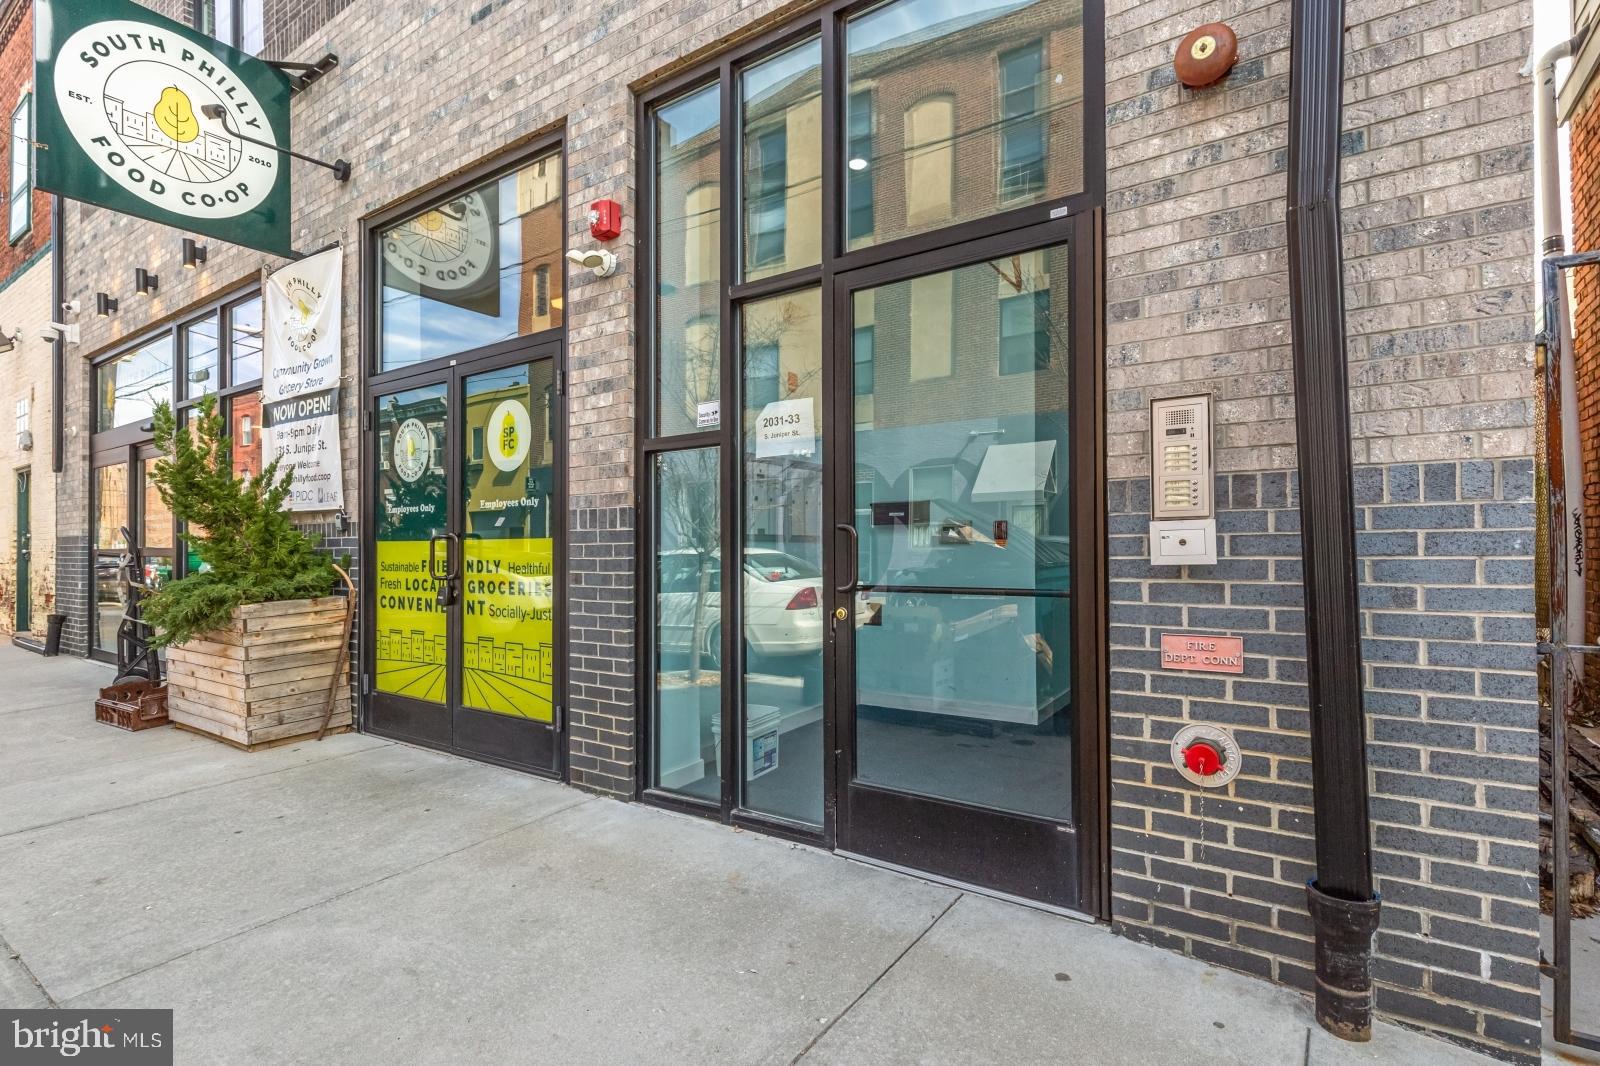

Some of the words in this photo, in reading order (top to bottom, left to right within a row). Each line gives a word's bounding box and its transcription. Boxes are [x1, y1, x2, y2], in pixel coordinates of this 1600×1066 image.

[80, 34, 166, 68] SOUTH
[181, 49, 261, 129] PHILLY
[68, 90, 93, 105] EST.
[91, 135, 166, 195] FOOD
[248, 155, 272, 168] 2010
[313, 354, 333, 370] Grown
[304, 375, 324, 390] Store
[273, 402, 296, 423] NOW
[298, 395, 331, 417] OPEN!
[763, 413, 800, 428] 2031-33
[503, 427, 514, 438] SP
[770, 431, 790, 440] Juniper
[318, 440, 327, 450] St.
[503, 438, 515, 450] FC
[296, 490, 314, 502] PIDC
[388, 504, 419, 515] Employees
[420, 503, 435, 513] Only
[480, 498, 519, 510] Employees
[520, 497, 540, 508] Only
[380, 561, 419, 573] Sustainable
[508, 561, 551, 575] Healthful
[380, 577, 402, 589] Fresh
[488, 604, 552, 622] Socially-Just
[1186, 641, 1217, 652] FIRE
[1165, 653, 1196, 664] DEPT.
